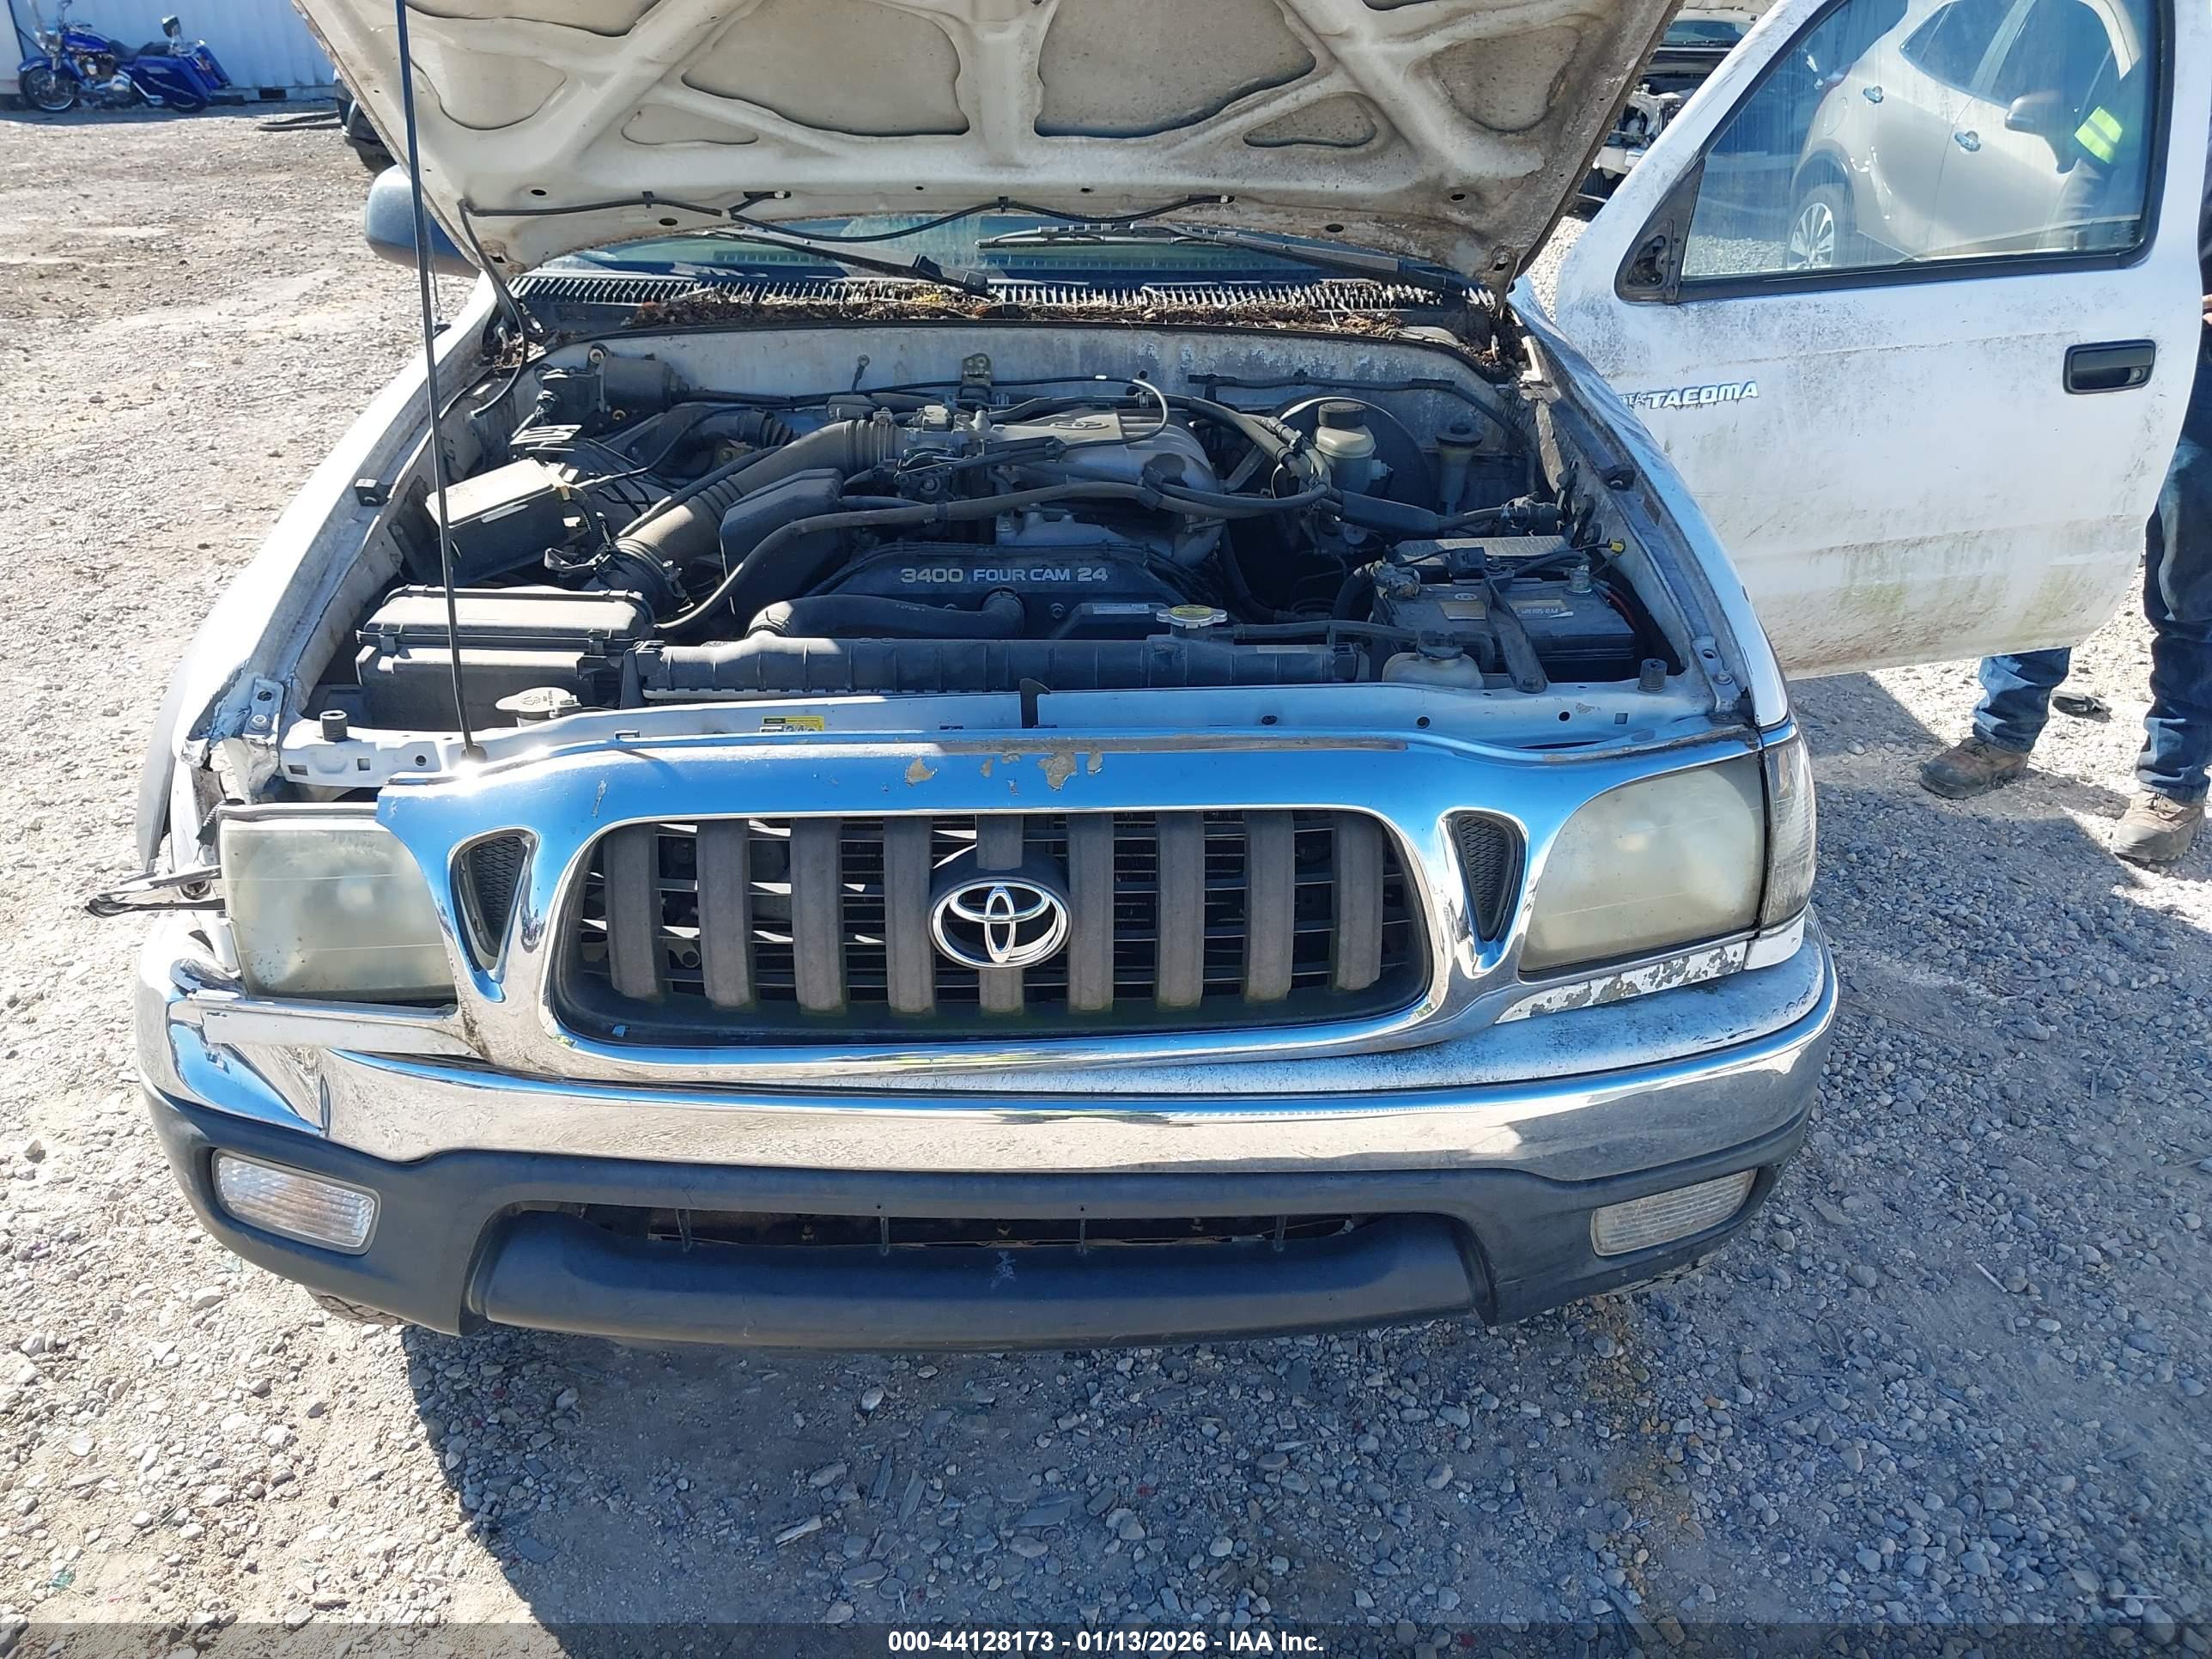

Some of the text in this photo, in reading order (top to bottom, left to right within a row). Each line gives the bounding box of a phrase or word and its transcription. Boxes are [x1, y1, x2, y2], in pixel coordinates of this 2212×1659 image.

[1647, 380, 1759, 409] TACOMA
[901, 567, 1108, 583] 3400 FOUR CAM 24
